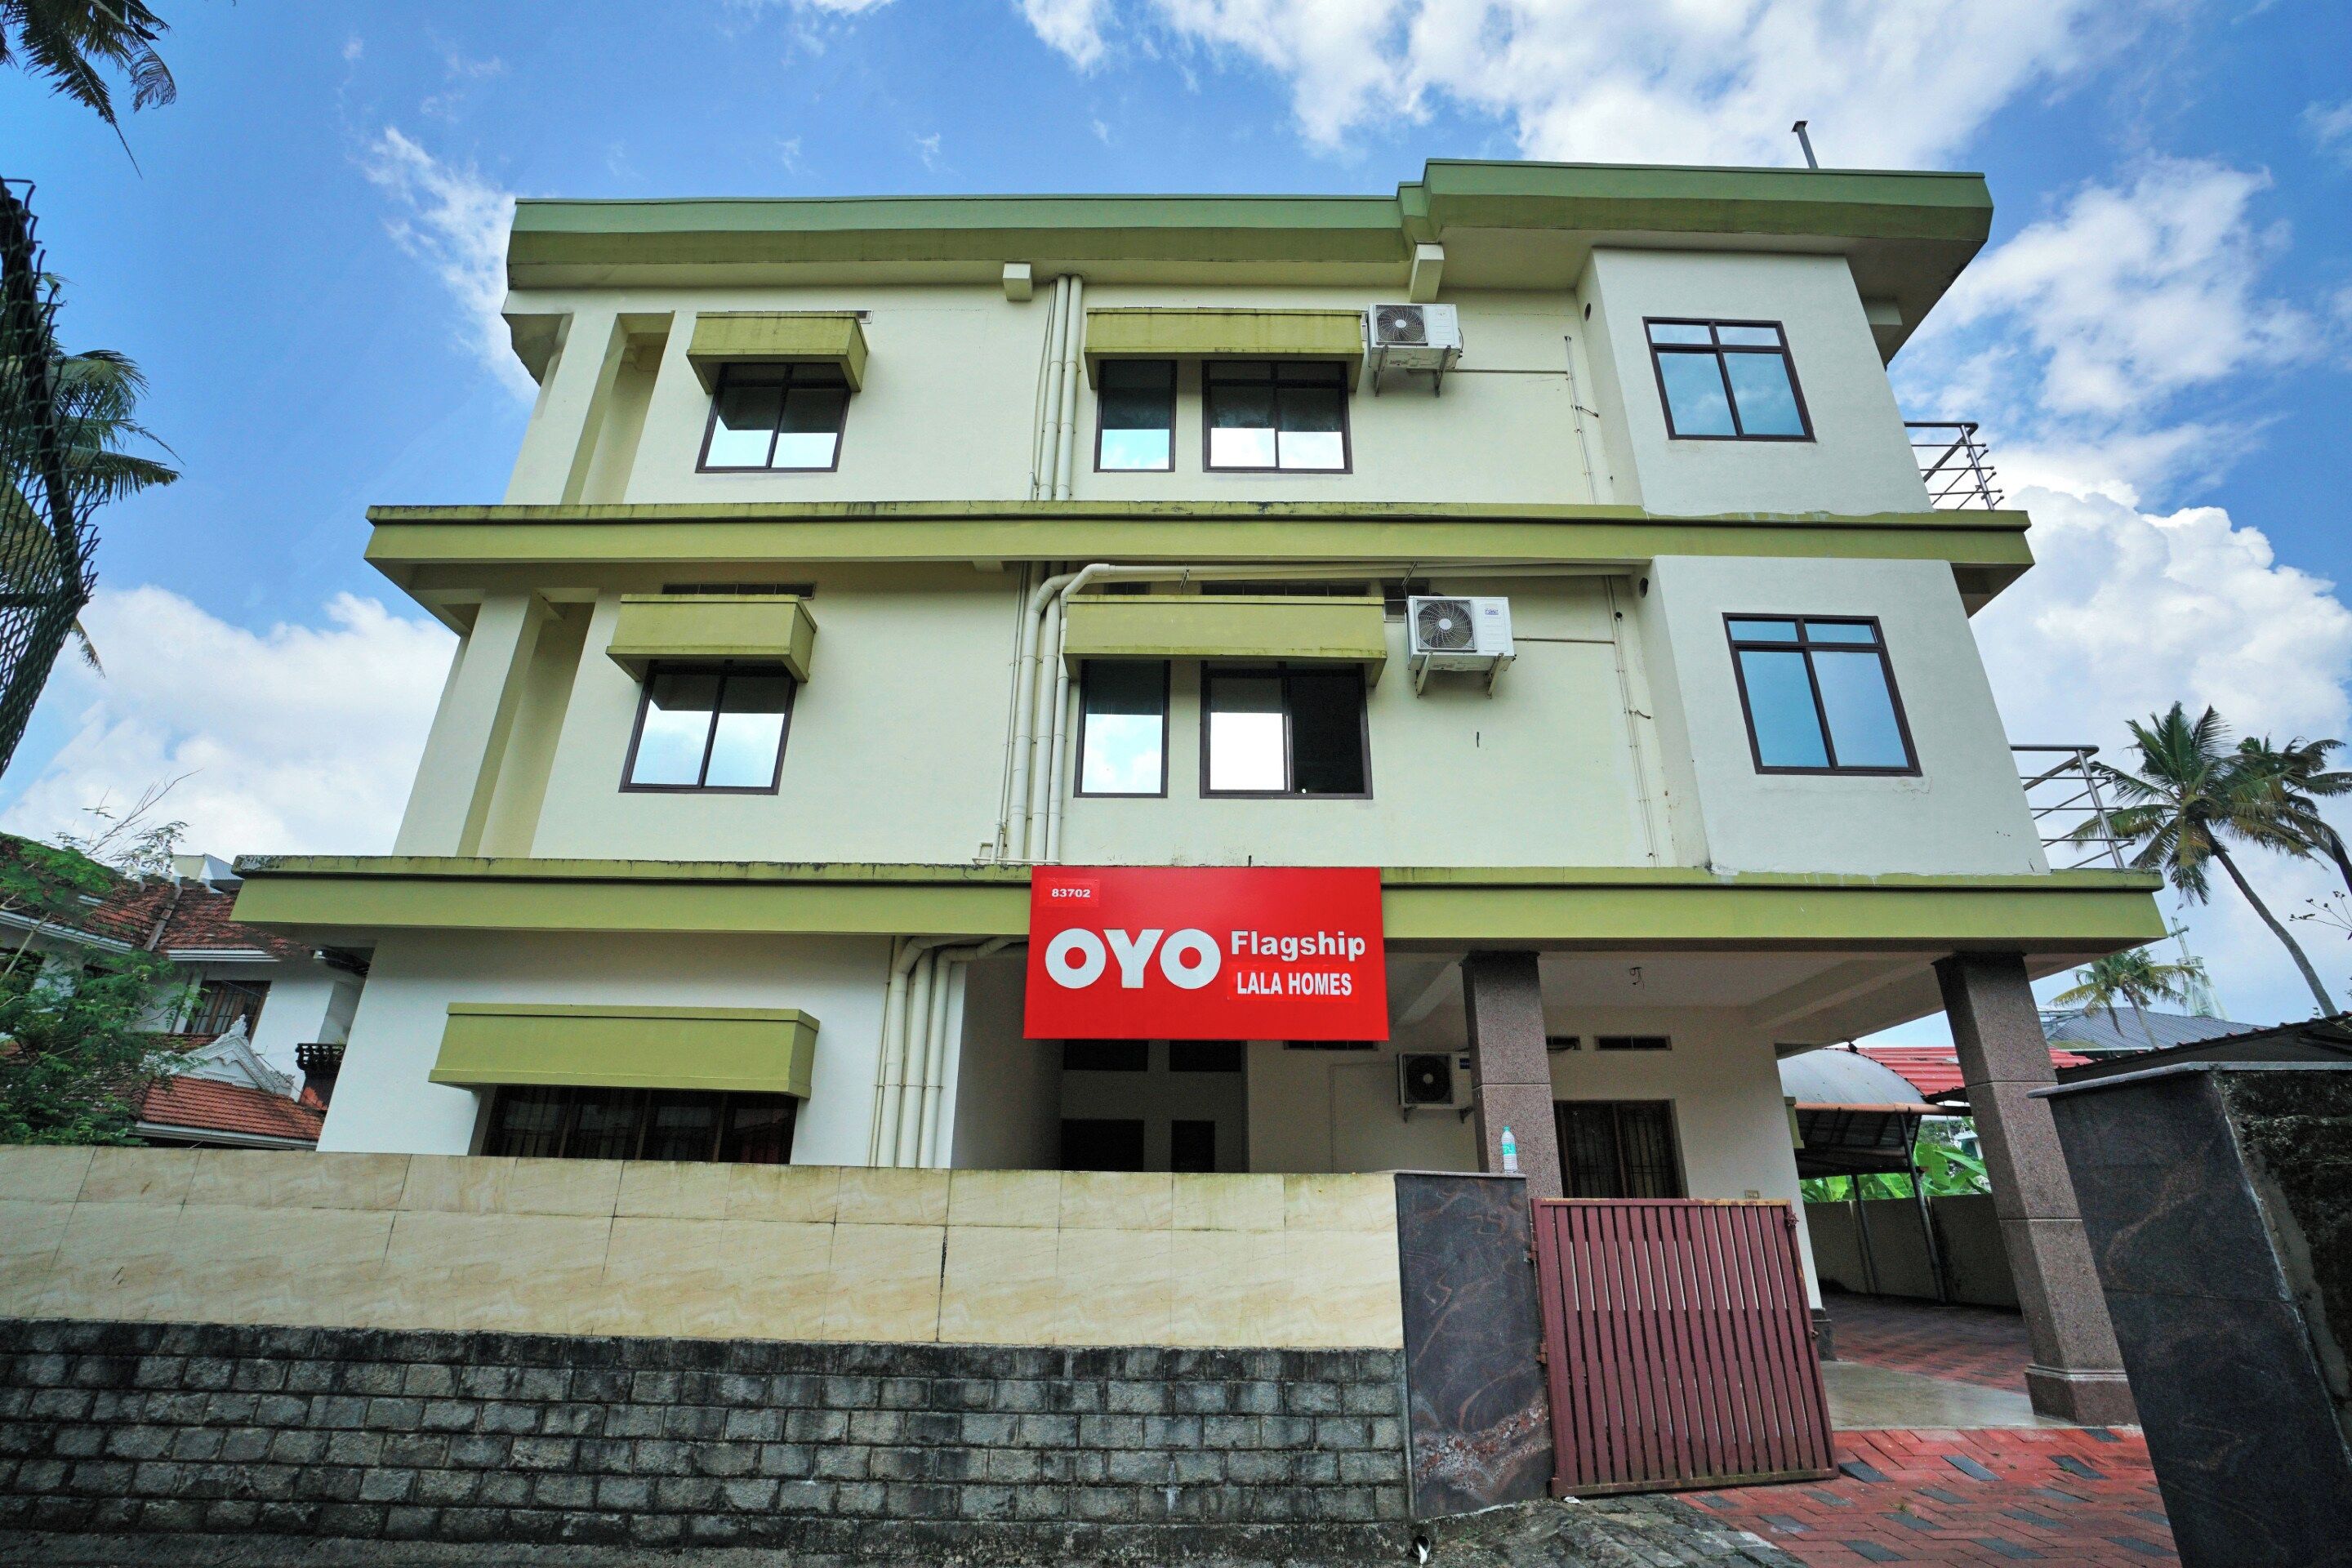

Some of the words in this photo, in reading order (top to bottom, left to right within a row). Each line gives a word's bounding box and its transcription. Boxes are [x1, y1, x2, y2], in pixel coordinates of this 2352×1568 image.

[1051, 888, 1091, 898] 83702
[1045, 928, 1222, 990] OYO
[1231, 930, 1365, 961] Flagship
[1236, 972, 1283, 995] LALA
[1288, 972, 1352, 996] HOMES
